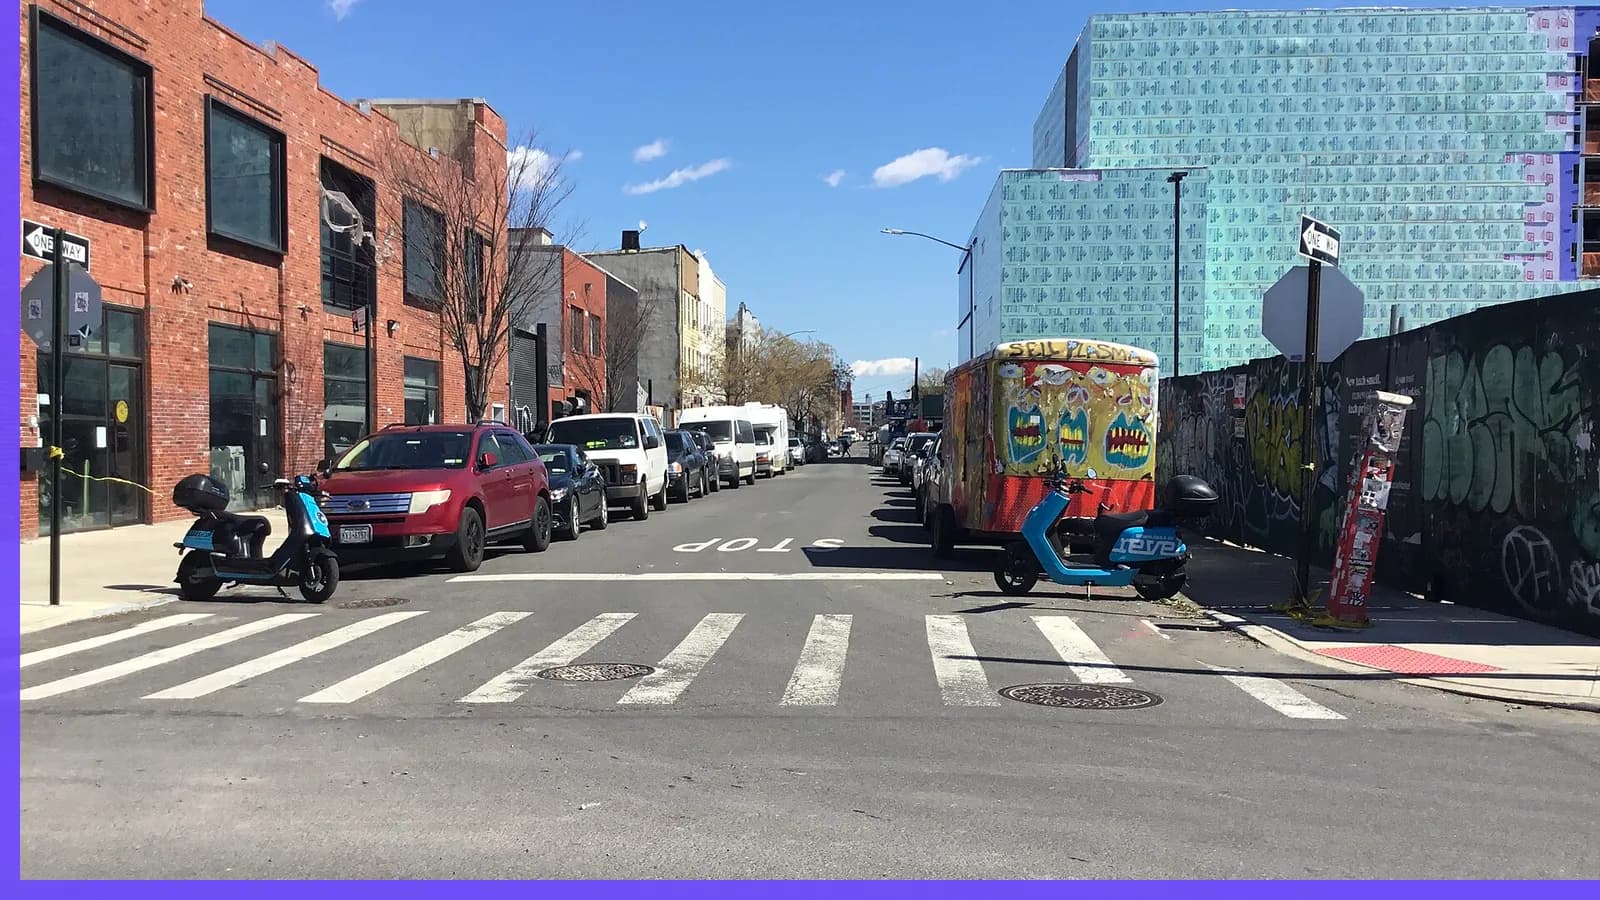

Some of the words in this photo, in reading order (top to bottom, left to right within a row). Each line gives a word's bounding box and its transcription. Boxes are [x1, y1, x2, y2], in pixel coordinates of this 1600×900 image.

[34, 234, 54, 251] ONE
[62, 242, 82, 258] WAY
[1307, 230, 1321, 248] ONE
[1008, 341, 1061, 357] SELL
[1067, 340, 1143, 362] PLASMA
[672, 537, 846, 552] STOP
